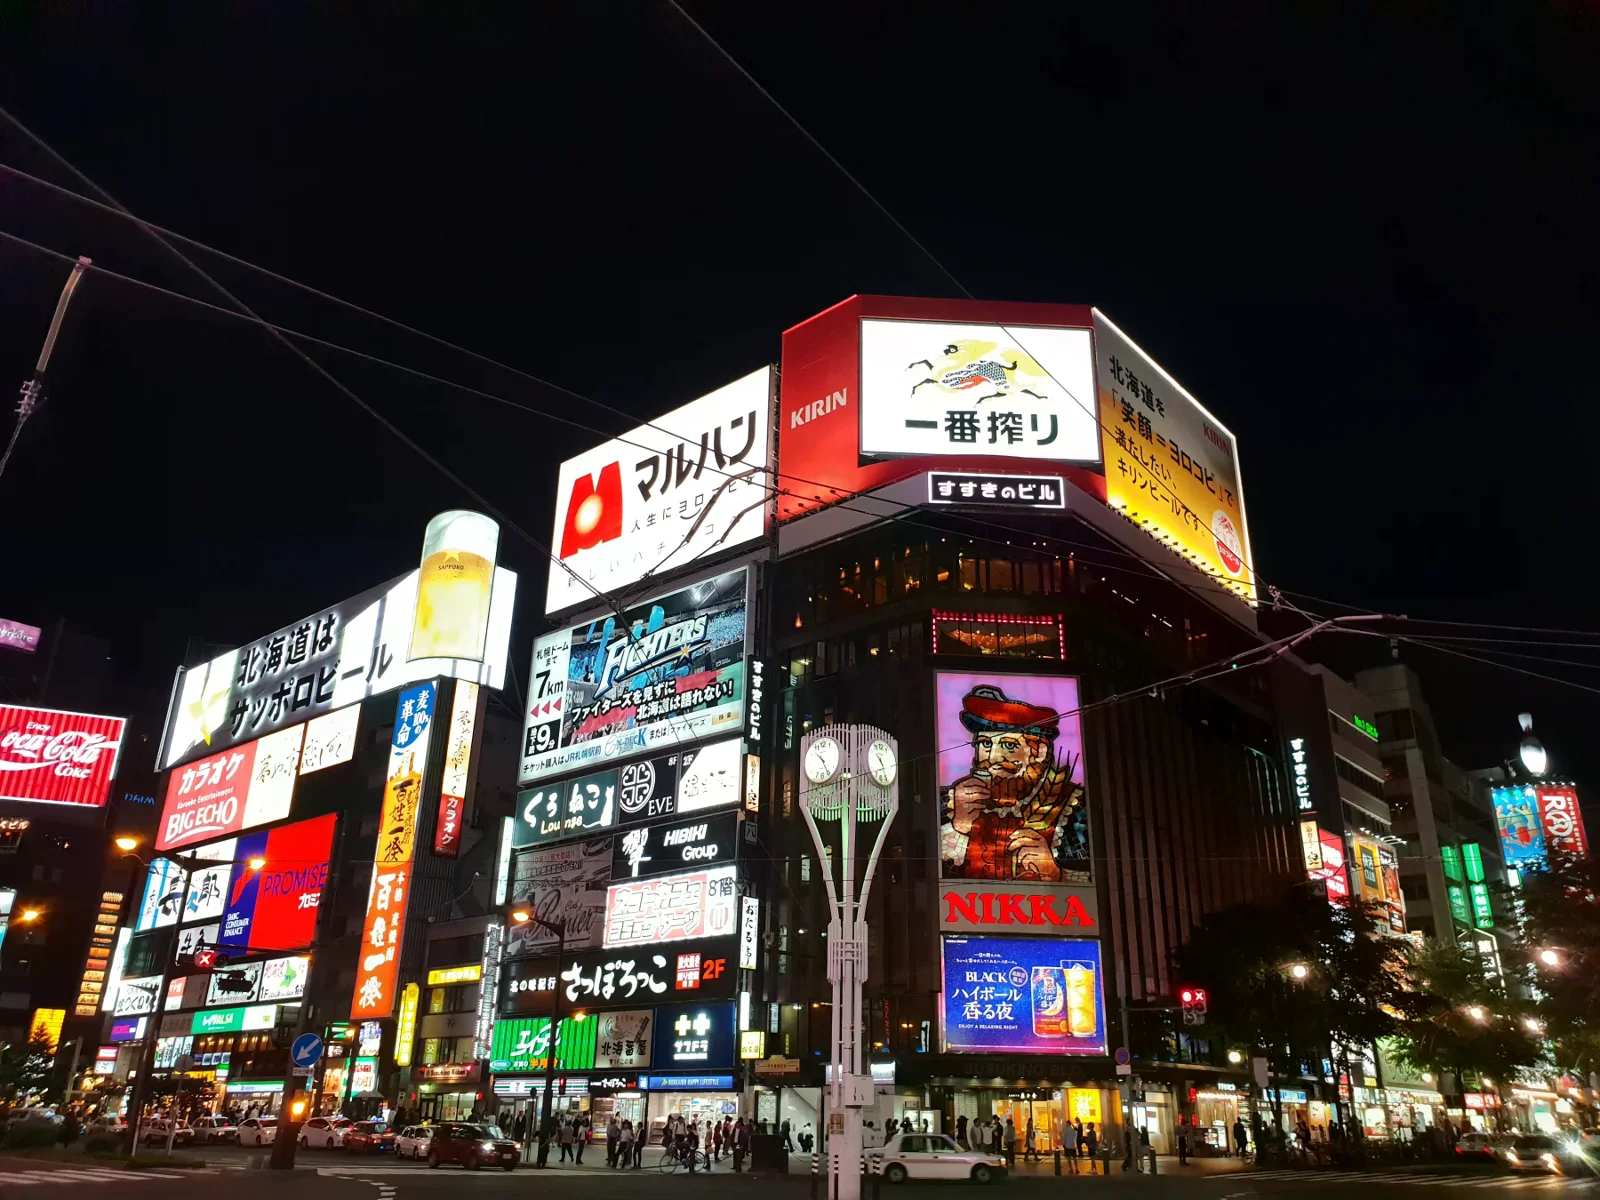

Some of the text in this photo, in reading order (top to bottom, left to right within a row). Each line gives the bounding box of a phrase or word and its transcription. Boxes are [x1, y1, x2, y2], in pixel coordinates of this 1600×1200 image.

[1109, 355, 1166, 419] 北海道を
[790, 387, 848, 430] KIRIN
[904, 409, 1060, 446] 一番搾り
[1202, 421, 1232, 458] KIRIN
[634, 410, 757, 503] マルハン
[937, 480, 1056, 502] すすきのビル
[437, 563, 465, 571] SAPPORO
[236, 613, 339, 687] 北海道は
[536, 640, 569, 660] 札幌ドーム
[544, 655, 559, 666] まで
[593, 613, 709, 700] FIGHTERS
[230, 642, 394, 739] サッポロビール
[535, 669, 564, 699] 7km
[571, 679, 677, 722] ファイターズを見ずに
[750, 660, 764, 741] すすきのビル
[26, 721, 51, 732] Enjoy
[396, 699, 414, 746] 革命
[0, 731, 106, 764] oca-Cola
[668, 756, 679, 766] 8F
[54, 763, 91, 779] Coke
[177, 752, 245, 797] カラオケ
[1290, 737, 1312, 810] すすきのビル
[164, 796, 238, 844] BIG ECHO
[442, 796, 460, 845] カラオケ
[522, 782, 601, 828] くろねこ
[647, 795, 675, 817] EVE
[540, 814, 584, 835] Lounge
[663, 823, 709, 847] HIBIKI
[681, 842, 719, 862] Group
[262, 862, 330, 899] PROMISE
[611, 876, 734, 917] ネットカフェ 8階
[943, 891, 1096, 927] NIKKA
[223, 926, 244, 938] FINANCE
[225, 917, 250, 930] CONSUMER
[659, 910, 700, 937] ダーツ
[509, 954, 668, 1002] 北の味紀行 さっぽろっこ
[702, 958, 726, 981] 2F
[965, 971, 1008, 984] BLACK
[951, 985, 1024, 1002] ハイボール
[961, 1000, 1015, 1021] 香る夜
[600, 1039, 649, 1057] 北海番屋
[964, 1062, 1044, 1075] SUSUKINO
